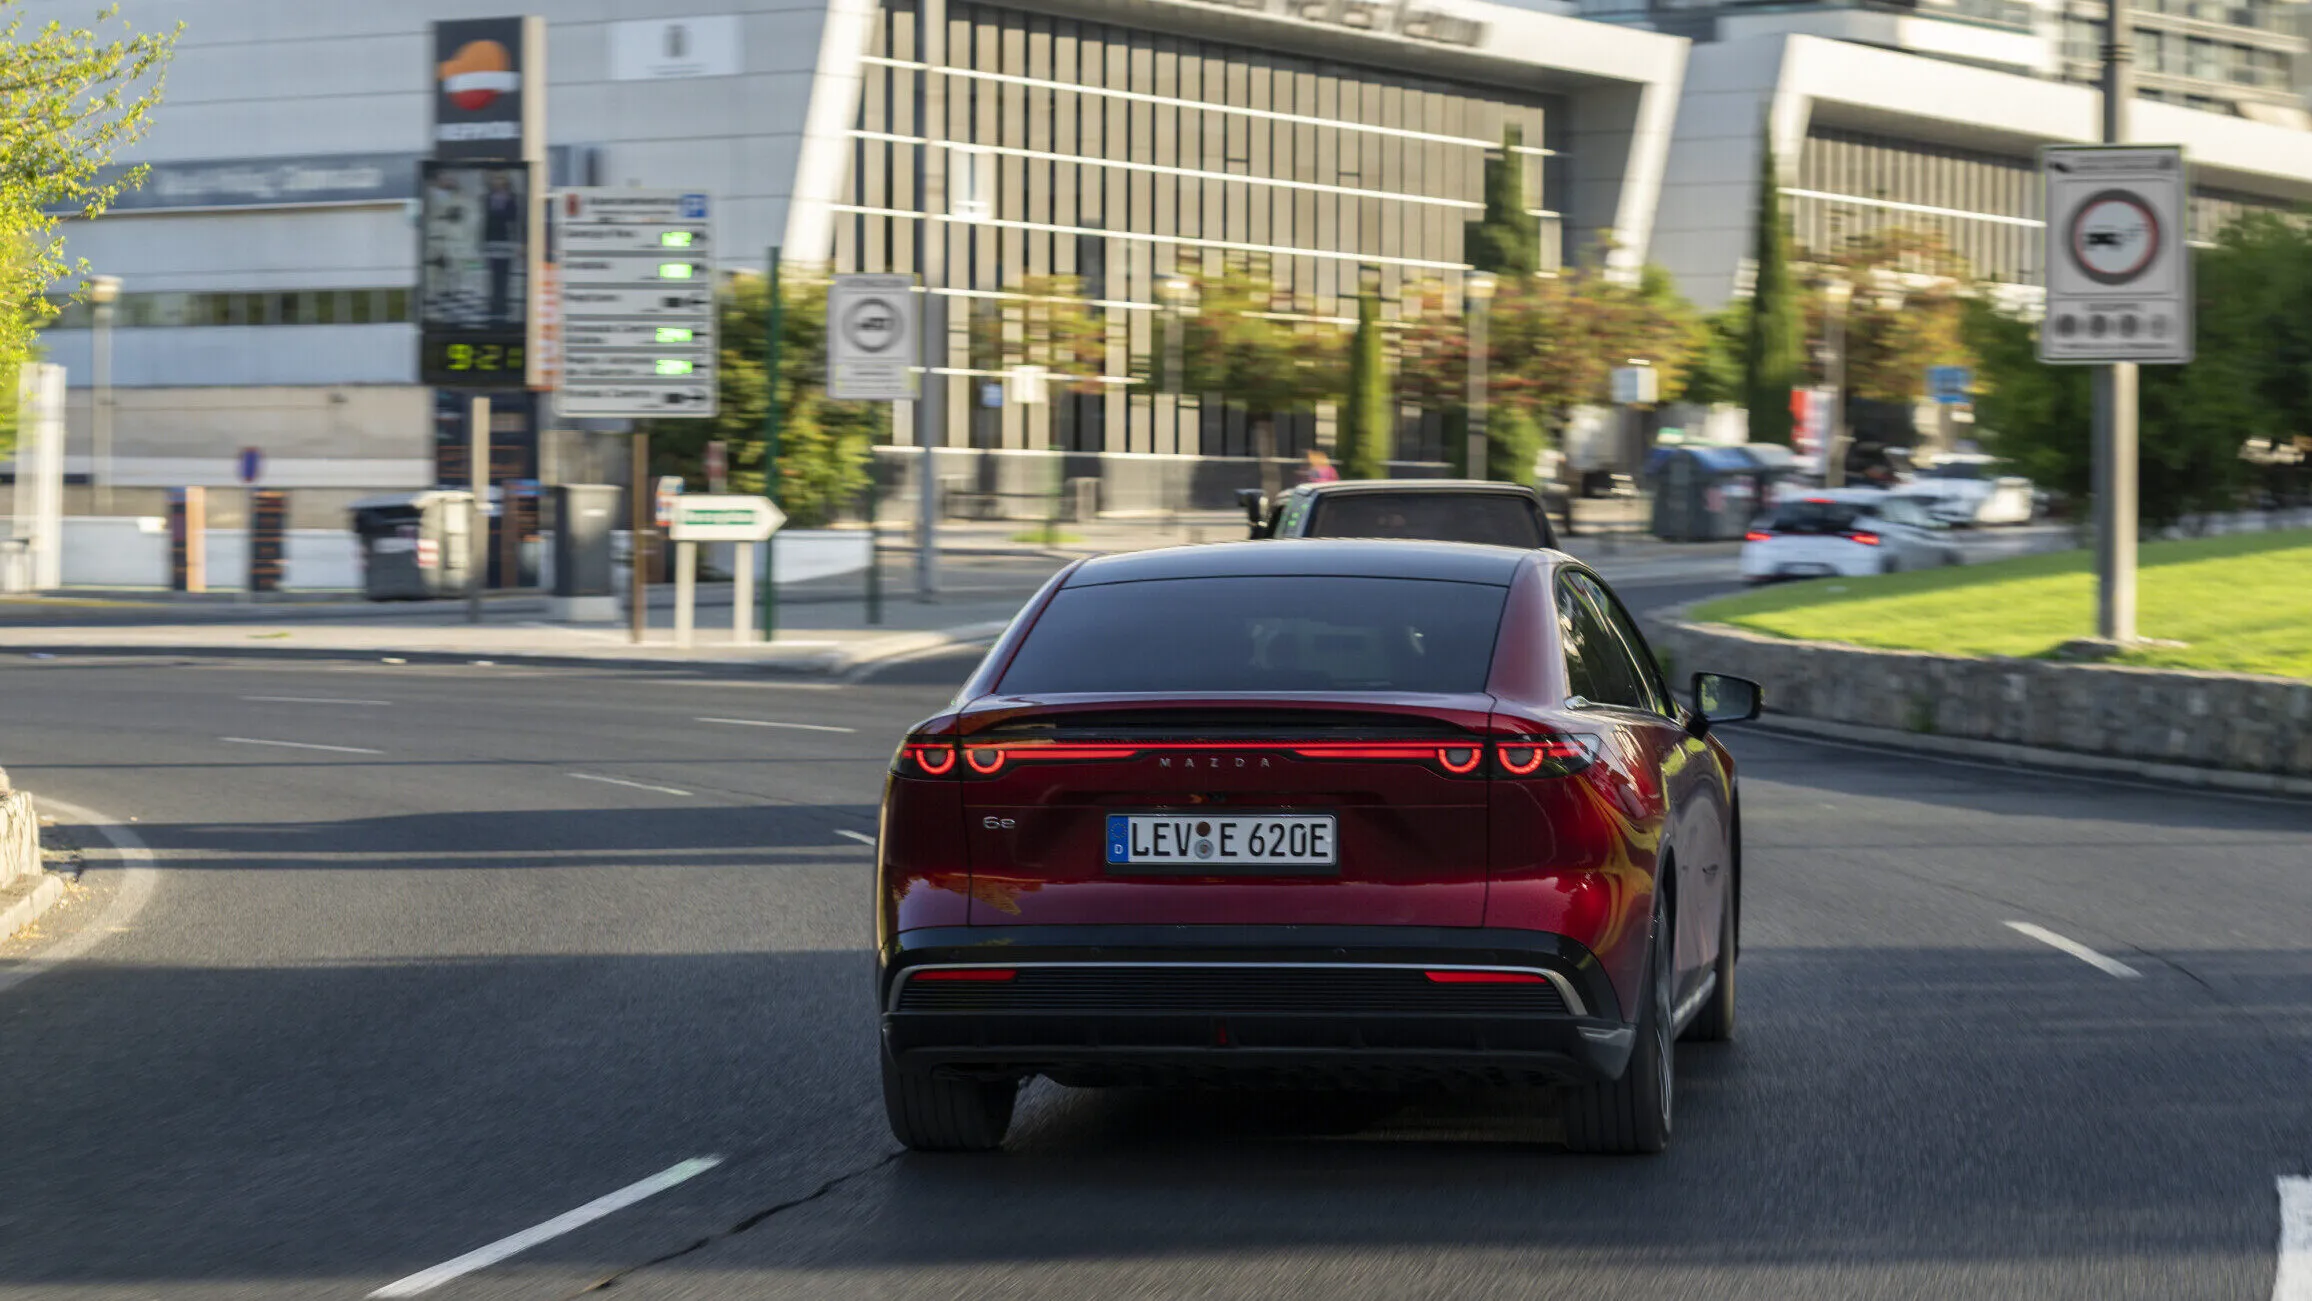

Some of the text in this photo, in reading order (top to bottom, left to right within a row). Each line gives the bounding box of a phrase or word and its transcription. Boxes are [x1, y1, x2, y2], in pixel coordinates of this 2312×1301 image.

[1159, 757, 1270, 768] MAZDA
[983, 816, 1015, 829] 6e
[1132, 822, 1328, 857] LEV E 620E
[1114, 844, 1123, 854] D
